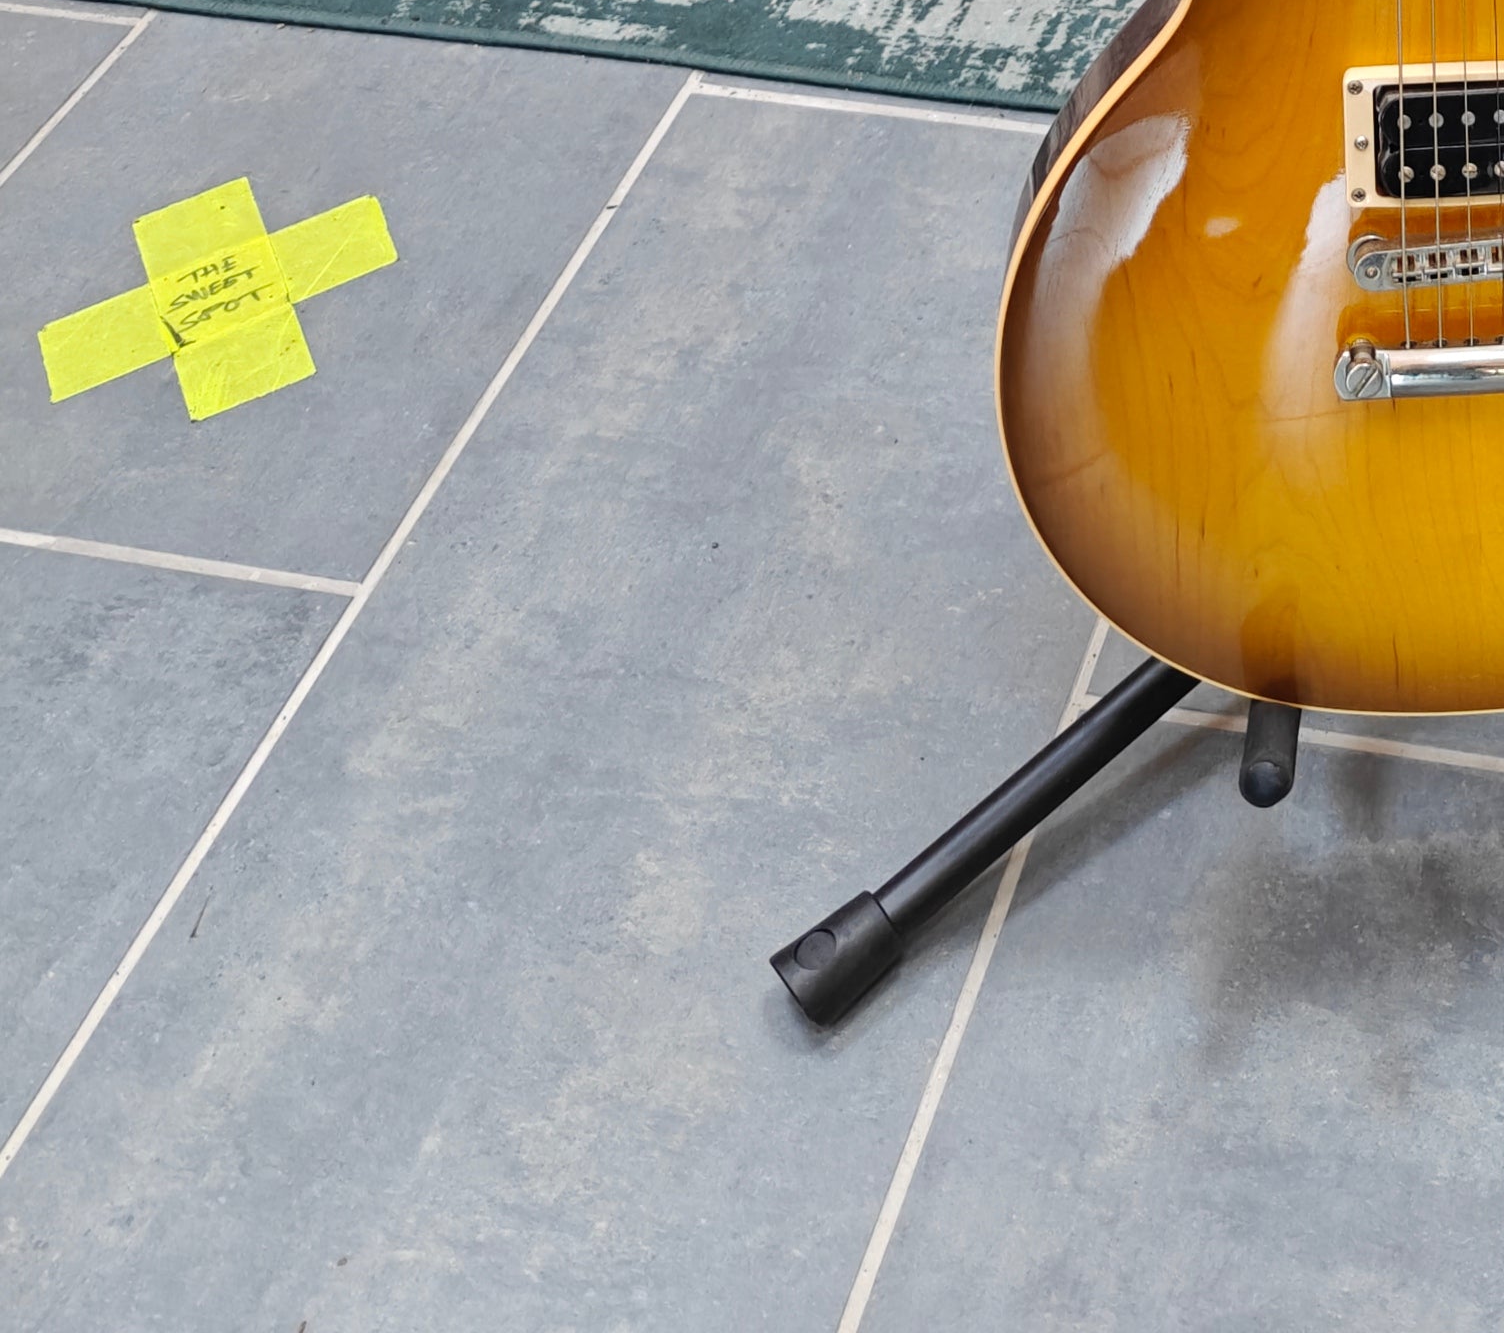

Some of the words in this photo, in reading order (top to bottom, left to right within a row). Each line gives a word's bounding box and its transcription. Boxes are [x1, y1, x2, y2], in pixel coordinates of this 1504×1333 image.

[167, 265, 260, 315] SWEET
[177, 255, 237, 284] THE
[176, 282, 274, 333] SPOT
